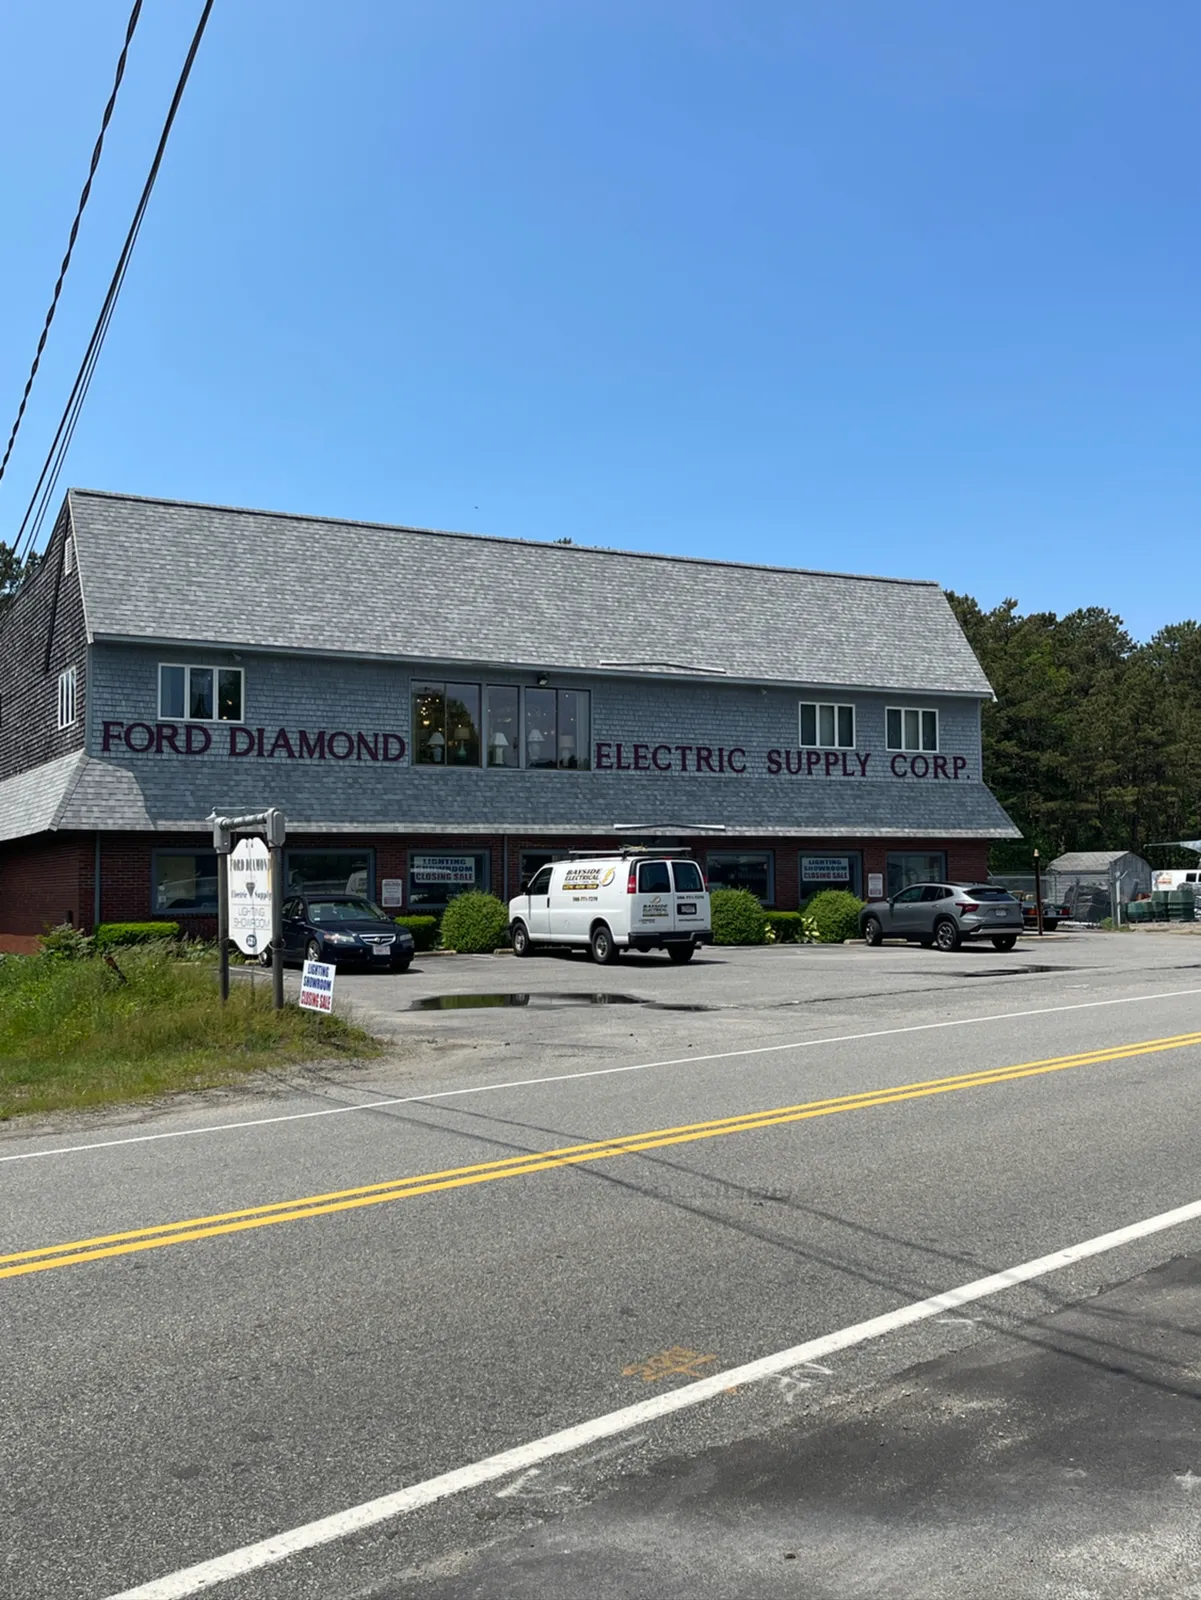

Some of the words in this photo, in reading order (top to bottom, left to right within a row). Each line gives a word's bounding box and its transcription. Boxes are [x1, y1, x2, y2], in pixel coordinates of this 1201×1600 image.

[101, 721, 212, 754] FORD
[229, 726, 406, 762] DIAMOND
[595, 742, 747, 774] ELECTRIC
[767, 749, 872, 778] SUPPLY
[890, 754, 971, 780] CORP.
[230, 858, 245, 871] FORD
[416, 872, 452, 881] CLOSING
[453, 872, 473, 881] SALE
[238, 907, 265, 917] LIGHTING
[308, 963, 329, 978] LIGHTING
[303, 975, 332, 991] SHOWROOM
[301, 990, 319, 1007] CLOSING
[320, 994, 331, 1010] SALE
